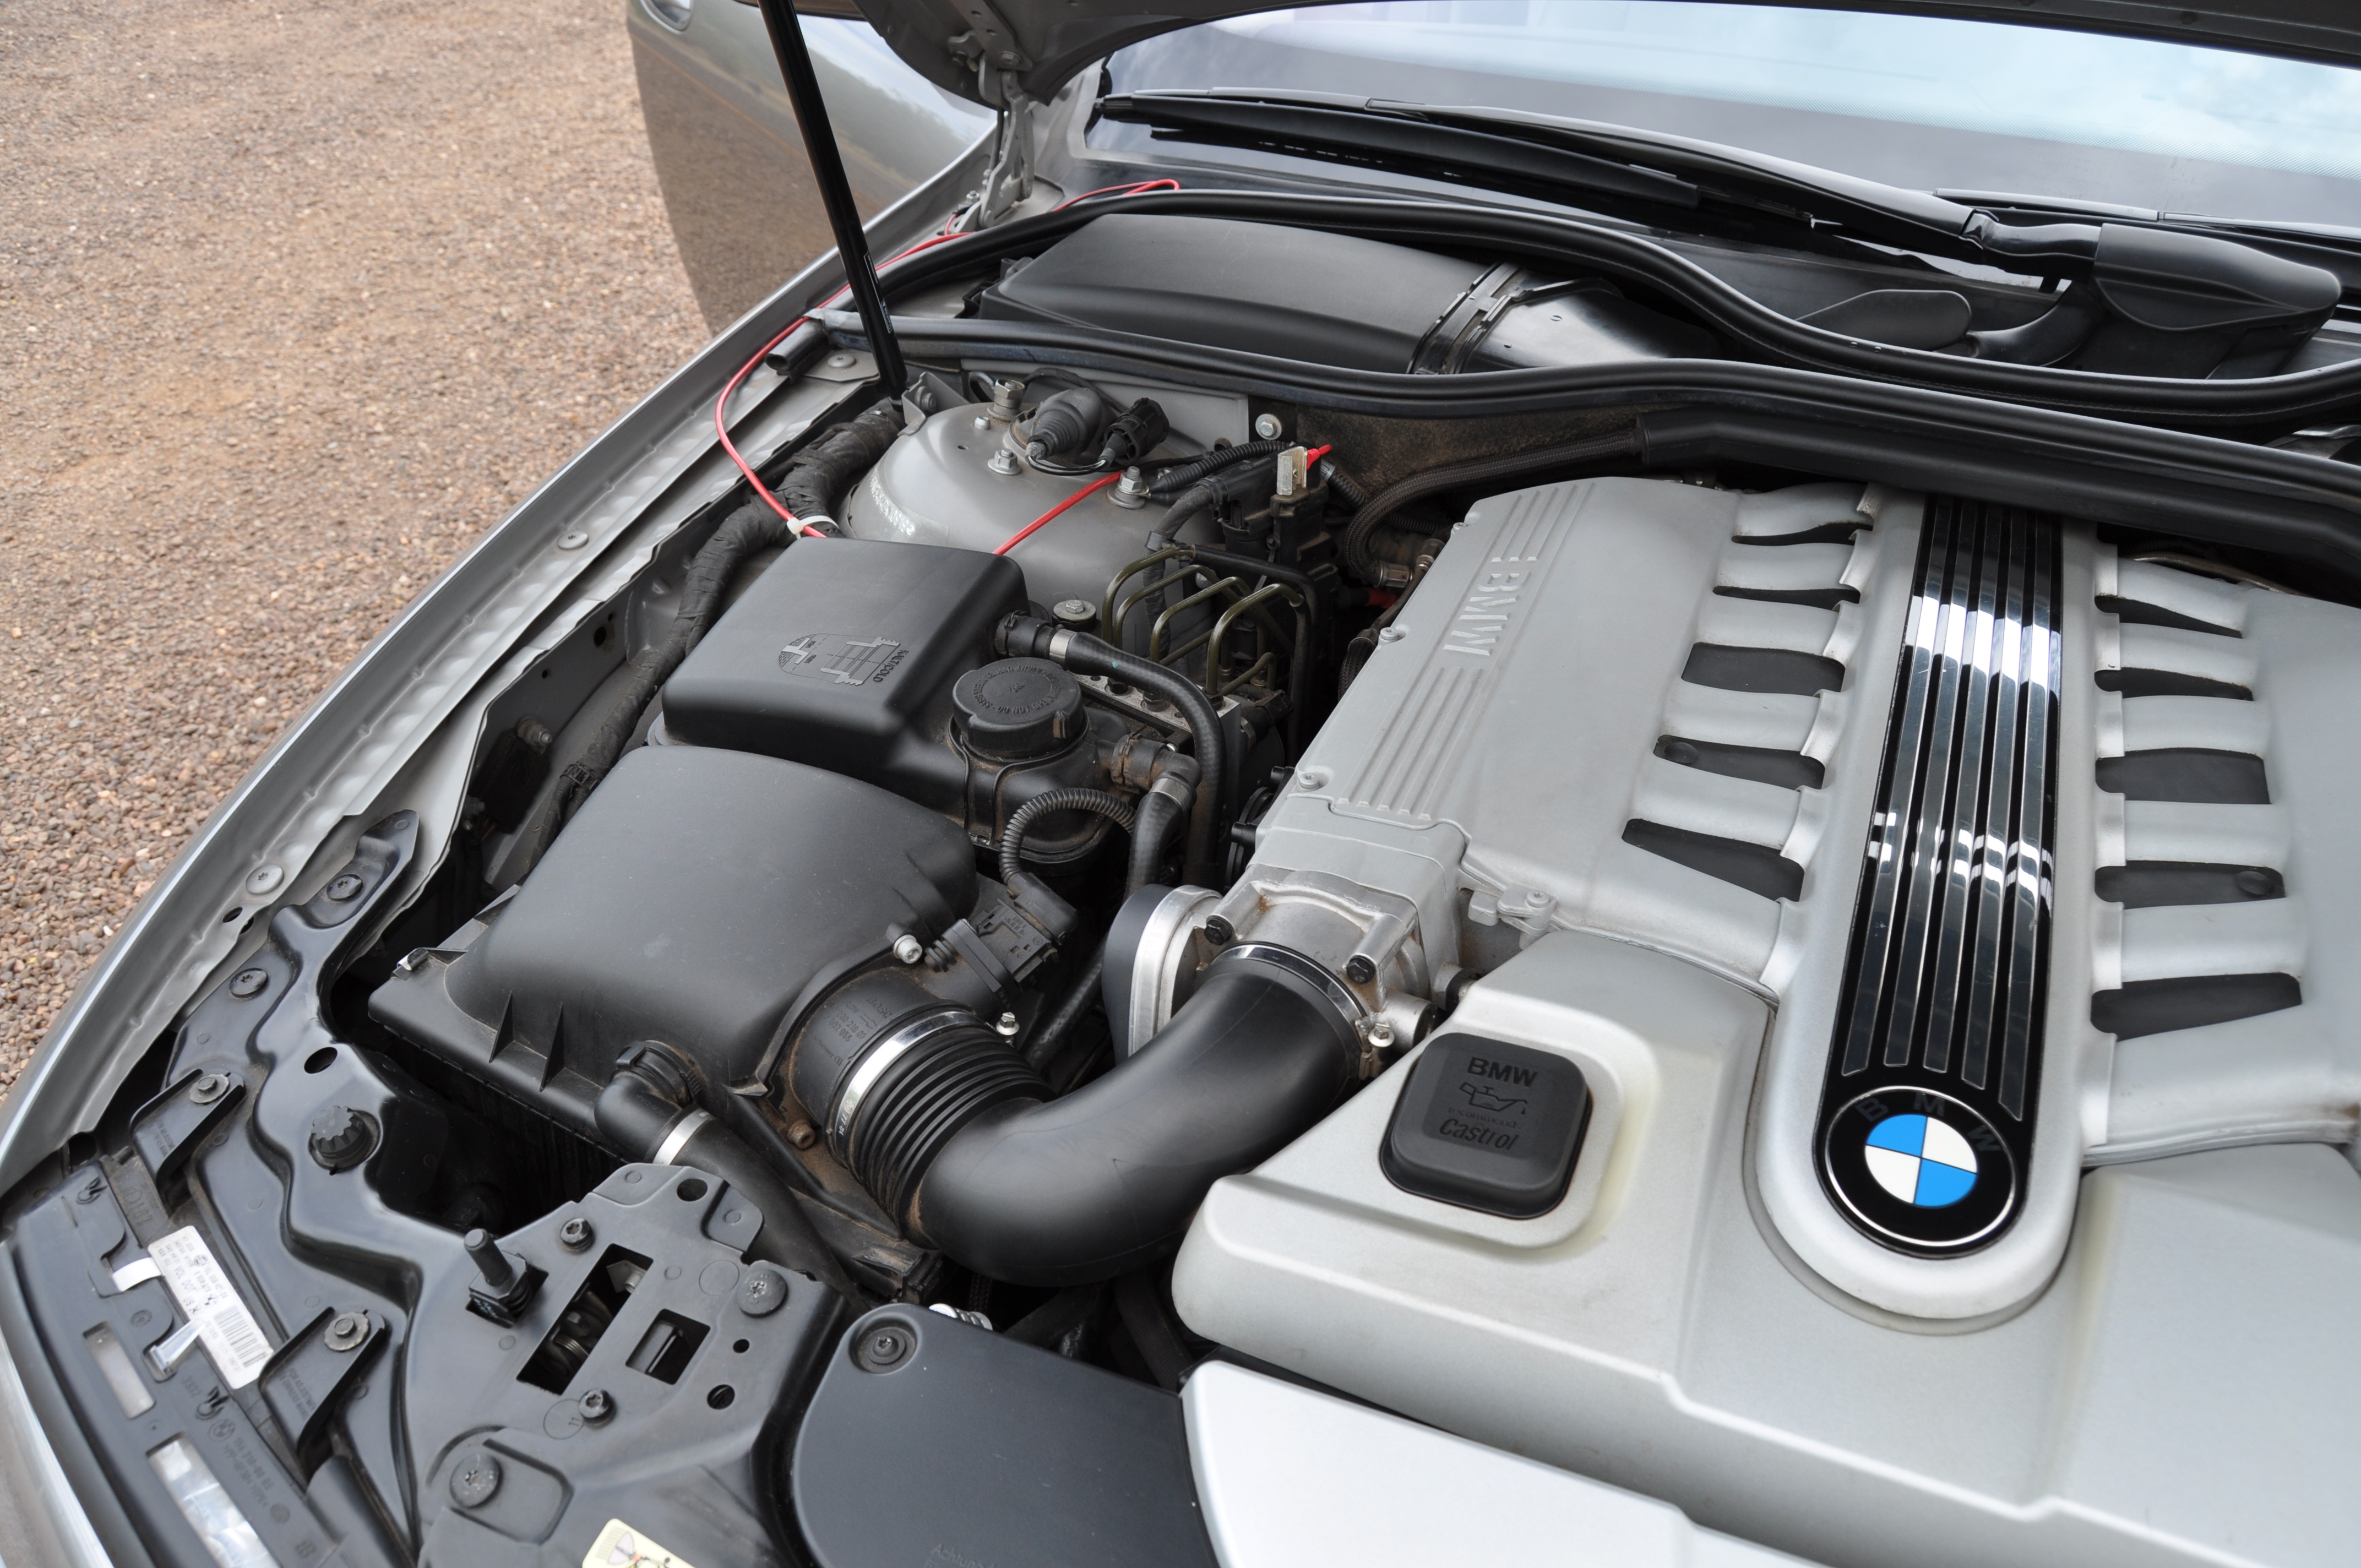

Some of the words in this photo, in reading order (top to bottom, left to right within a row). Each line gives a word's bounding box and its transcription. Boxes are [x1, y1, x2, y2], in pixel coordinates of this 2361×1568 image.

[1443, 570, 1531, 656] BMW
[873, 650, 909, 682] KALT/COLD
[866, 993, 892, 1021] BOSC
[837, 1027, 853, 1043] 055
[1467, 1057, 1537, 1087] BMW
[1449, 1107, 1521, 1129] recommends
[1855, 1092, 2001, 1152] BMW
[1439, 1118, 1519, 1150] Castrol
[182, 1278, 195, 1293] DOT
